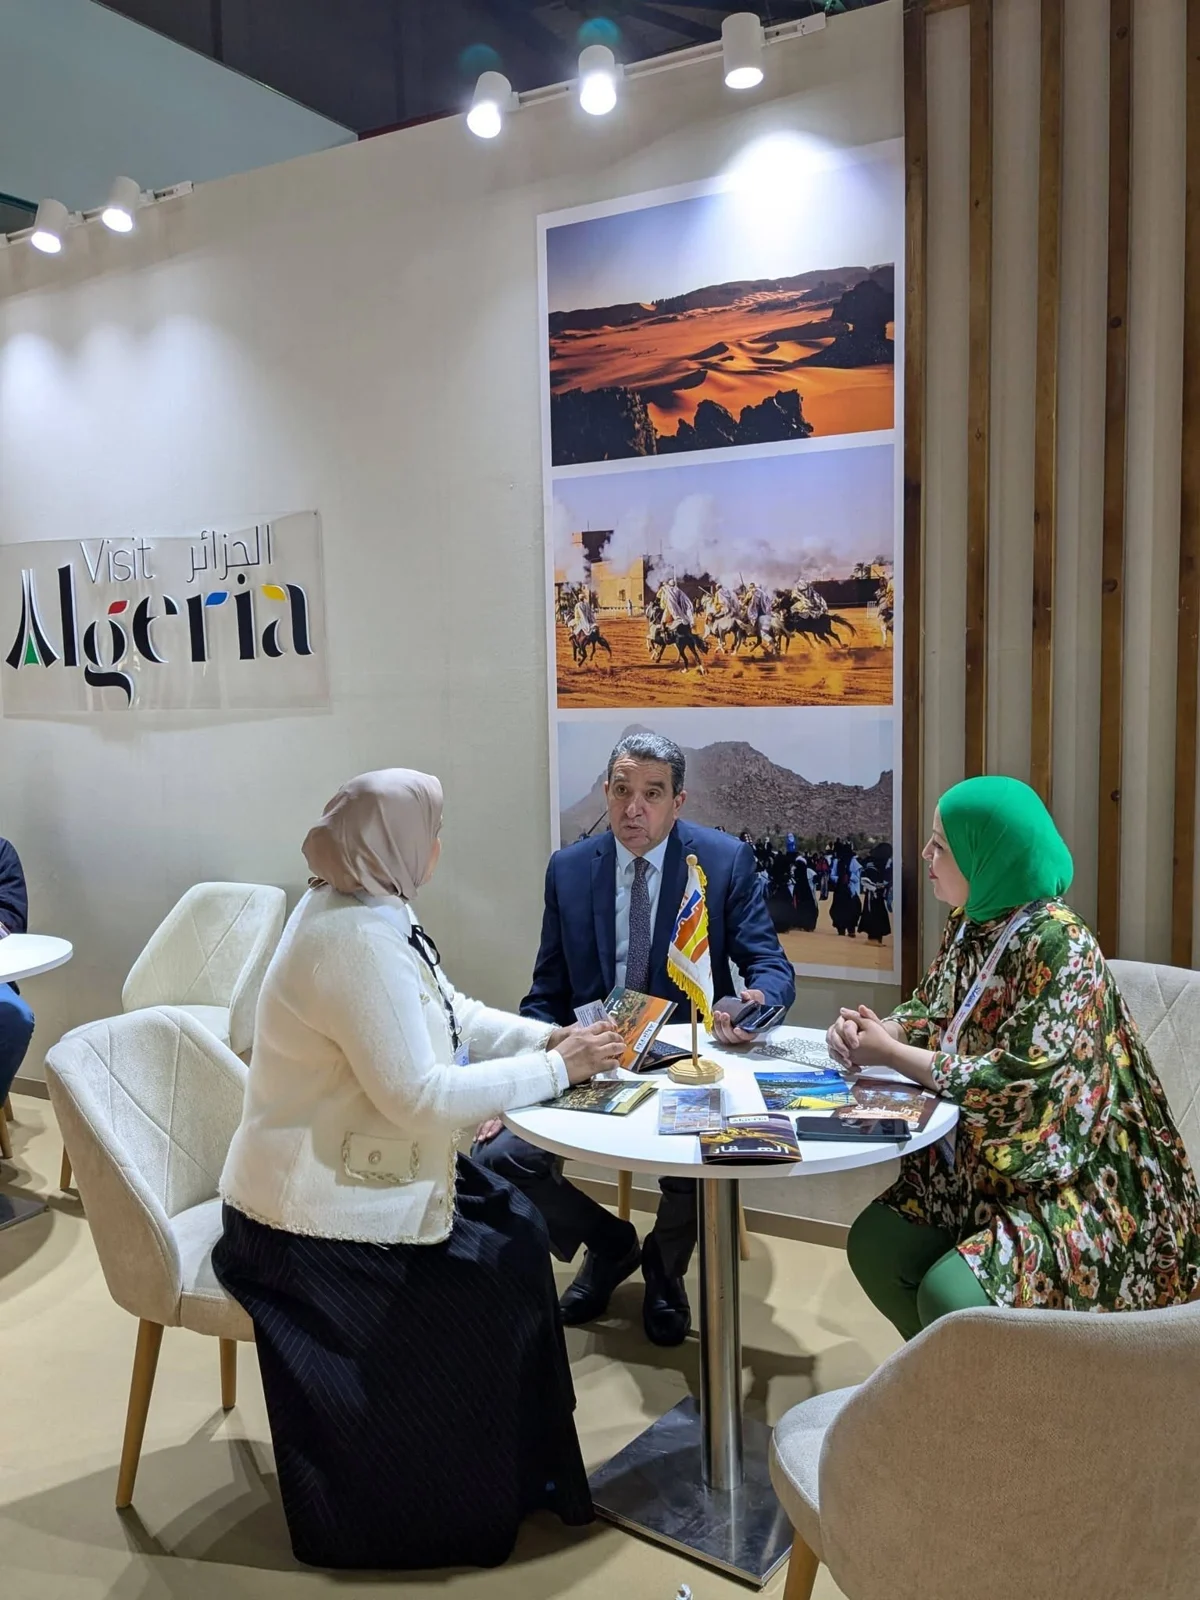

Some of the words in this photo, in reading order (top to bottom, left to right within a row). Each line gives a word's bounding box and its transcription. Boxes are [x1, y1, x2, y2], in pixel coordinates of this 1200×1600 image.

[80, 536, 155, 583] Visit
[186, 524, 273, 583] الجزائر
[5, 563, 315, 709] Algeria
